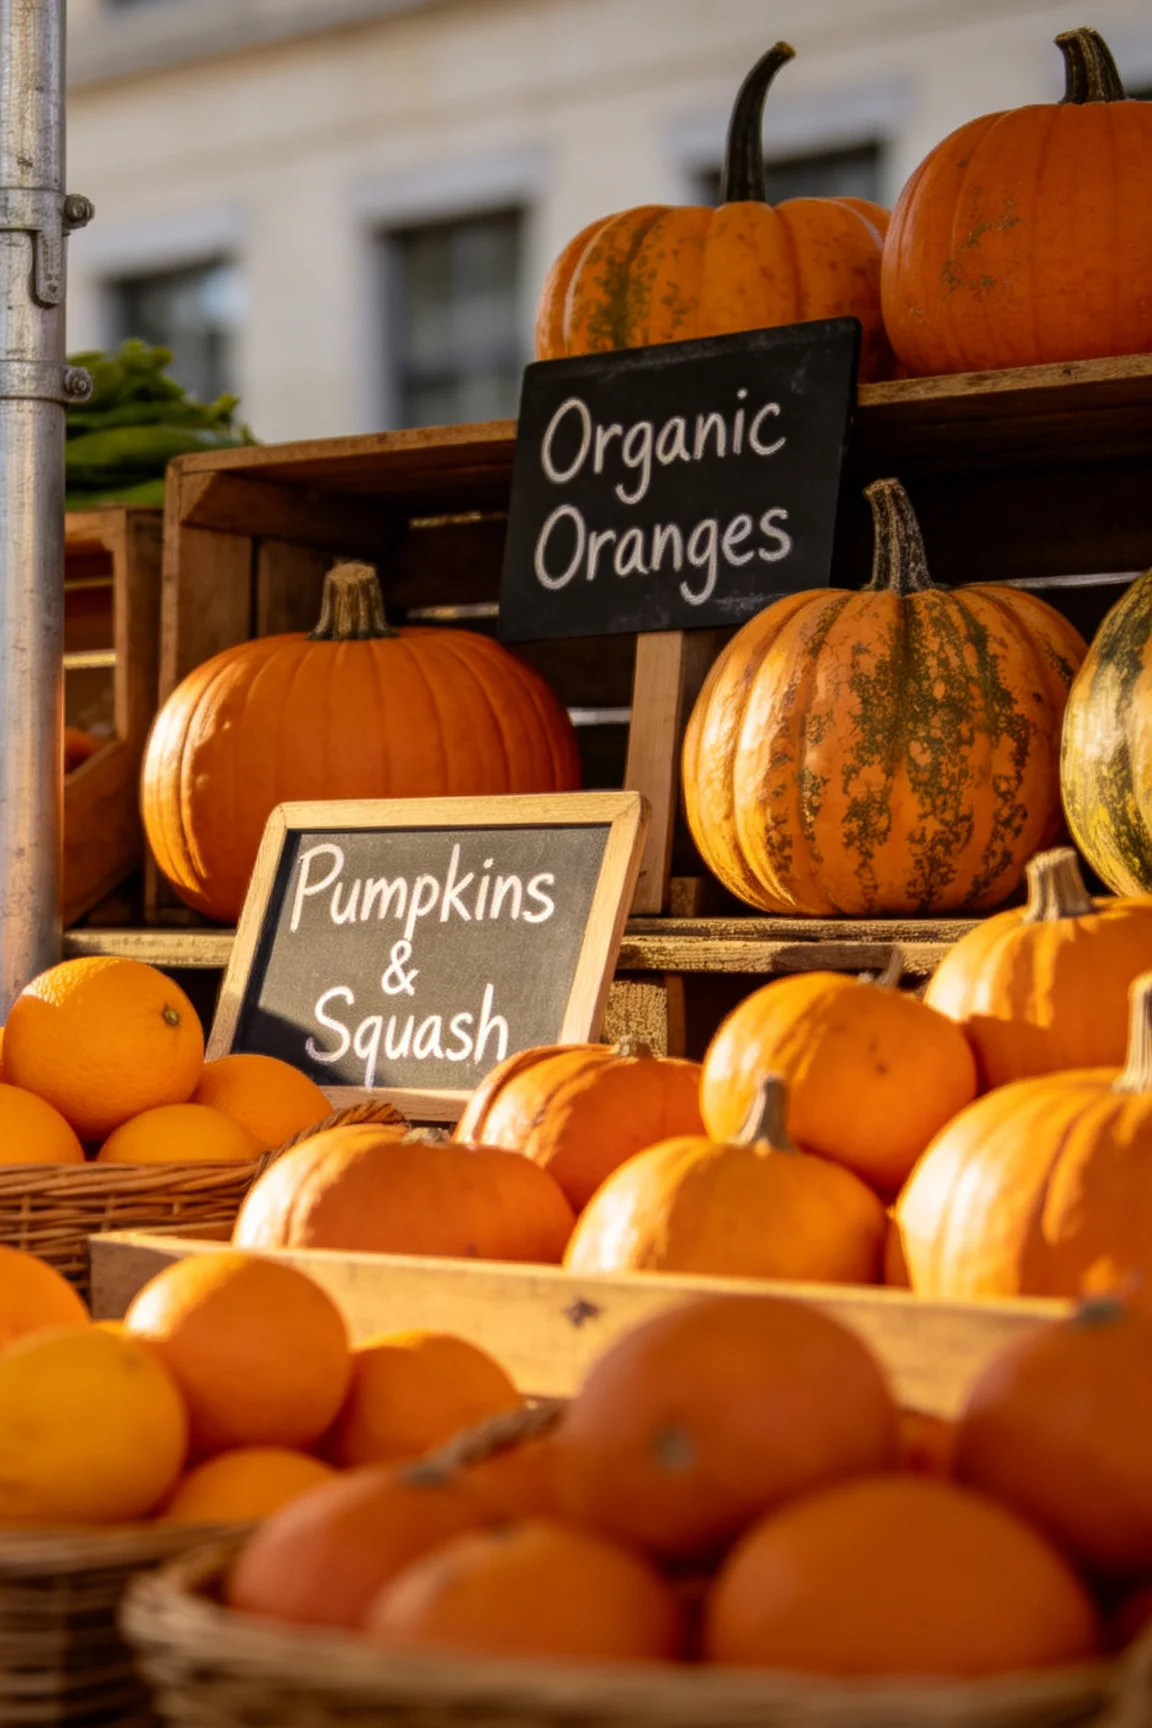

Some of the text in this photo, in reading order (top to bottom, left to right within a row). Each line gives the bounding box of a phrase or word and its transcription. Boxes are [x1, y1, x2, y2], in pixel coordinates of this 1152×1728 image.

[541, 387, 786, 505] Organic
[534, 504, 794, 606] Oranges
[289, 842, 556, 940] Pumpkins
[381, 939, 419, 997] &
[305, 983, 509, 1088] Squash
